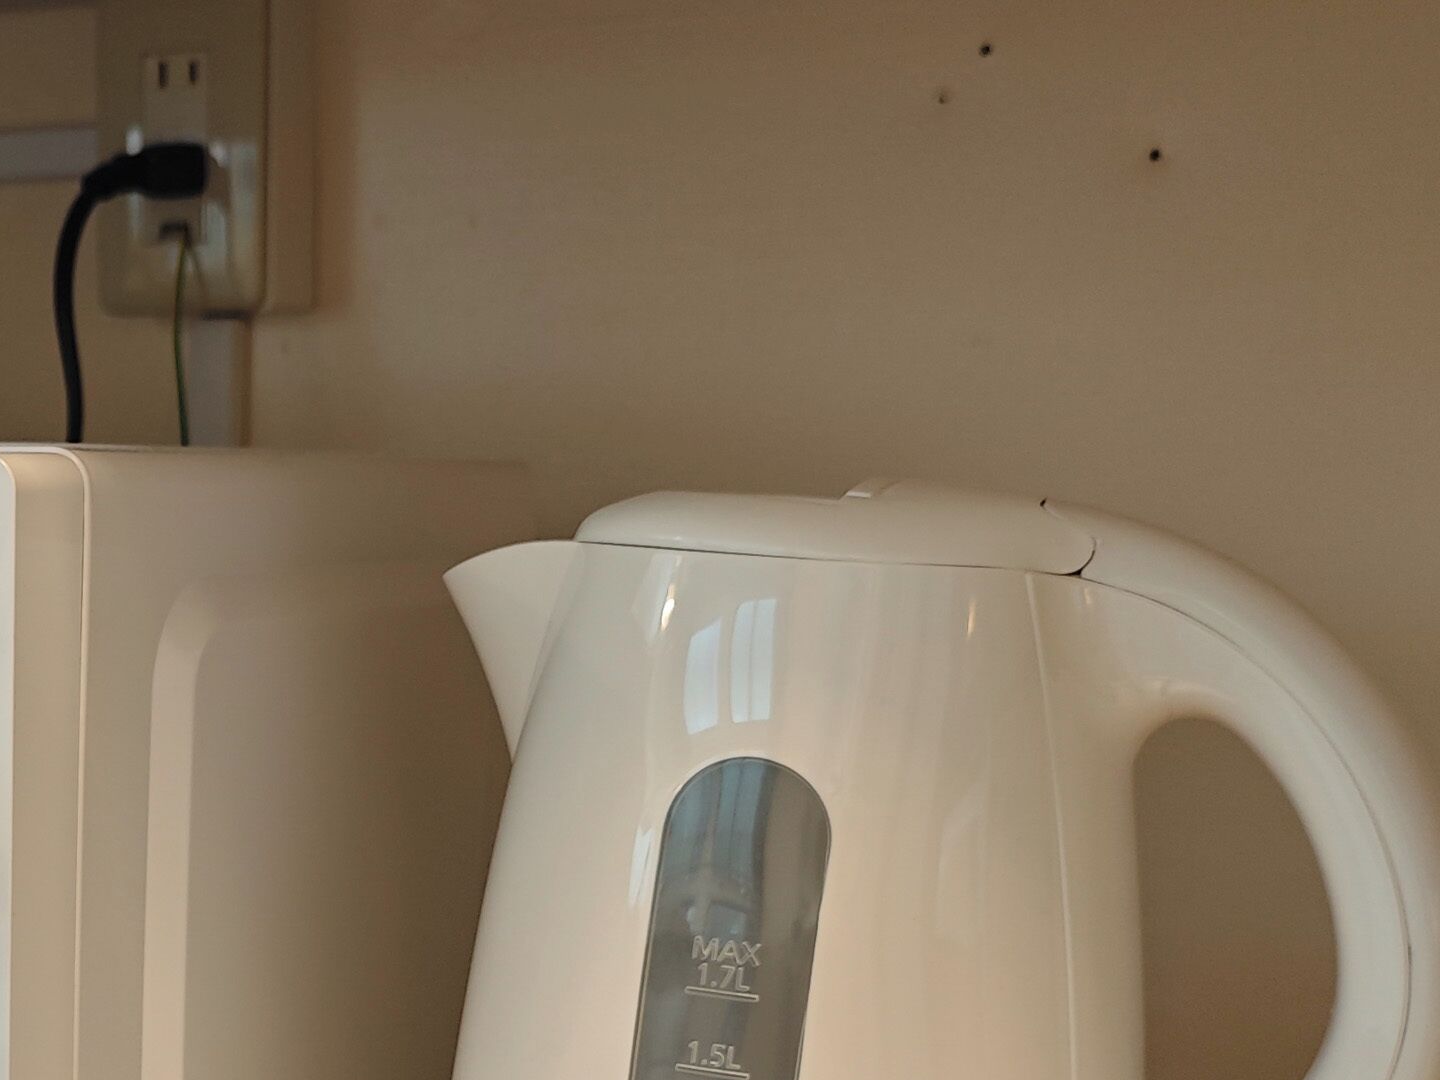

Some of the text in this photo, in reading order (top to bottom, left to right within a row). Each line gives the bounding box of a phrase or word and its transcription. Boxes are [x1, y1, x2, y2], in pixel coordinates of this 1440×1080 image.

[691, 935, 762, 967] MAX
[697, 962, 750, 992] 1.7L
[687, 1041, 742, 1070] 1.5L
